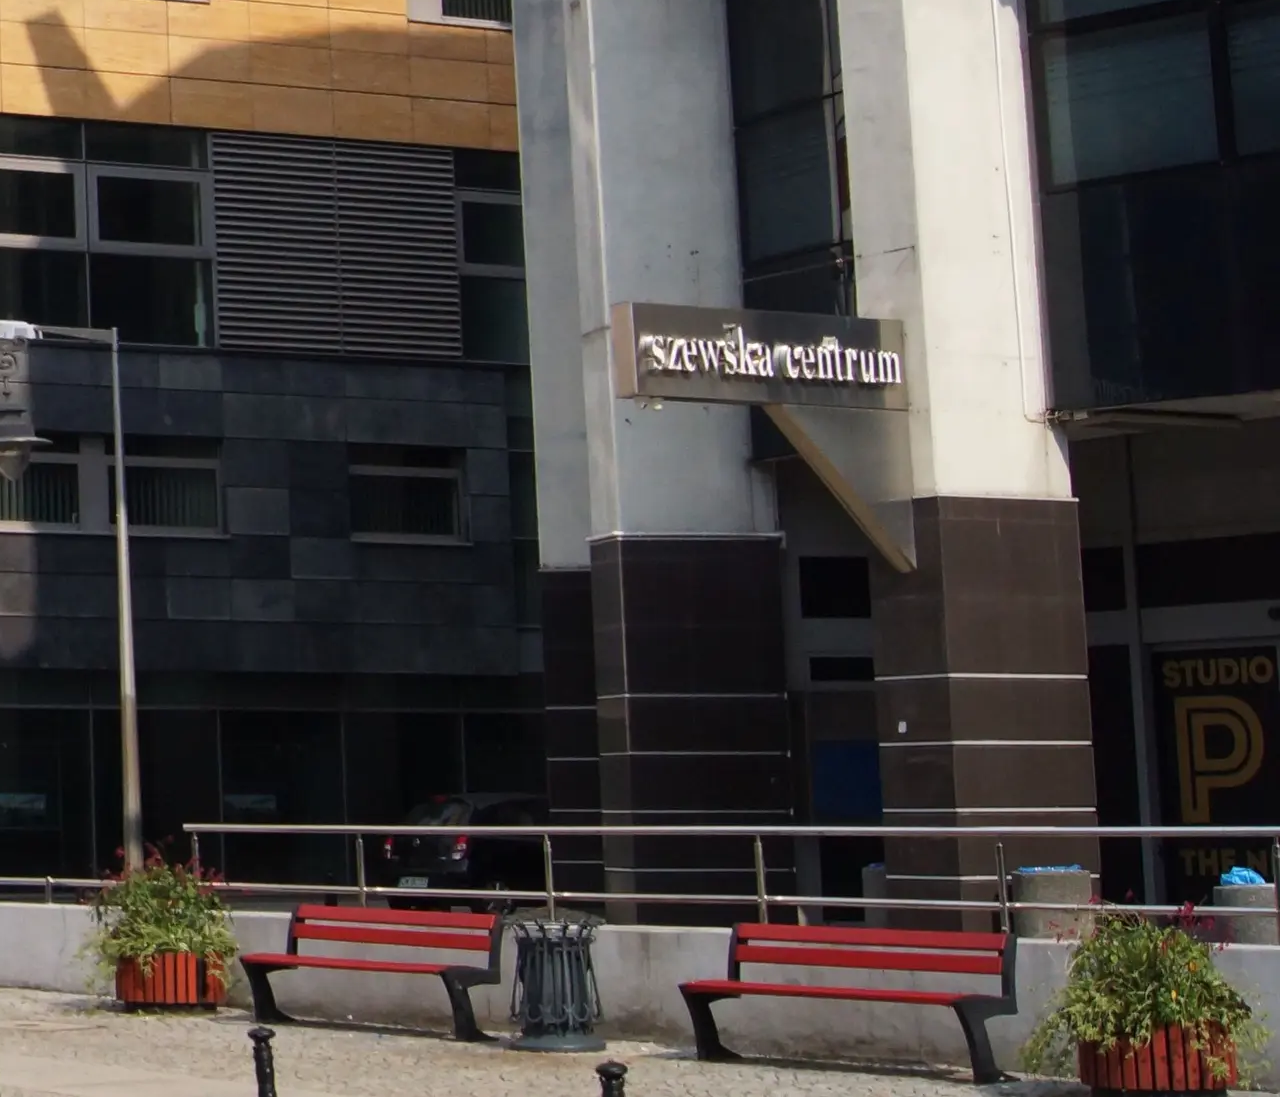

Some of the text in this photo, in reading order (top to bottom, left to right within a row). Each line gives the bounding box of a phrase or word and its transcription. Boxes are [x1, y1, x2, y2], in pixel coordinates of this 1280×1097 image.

[645, 326, 901, 384] szewska centrum
[1162, 656, 1273, 688] STUDIO
[1174, 695, 1265, 824] P
